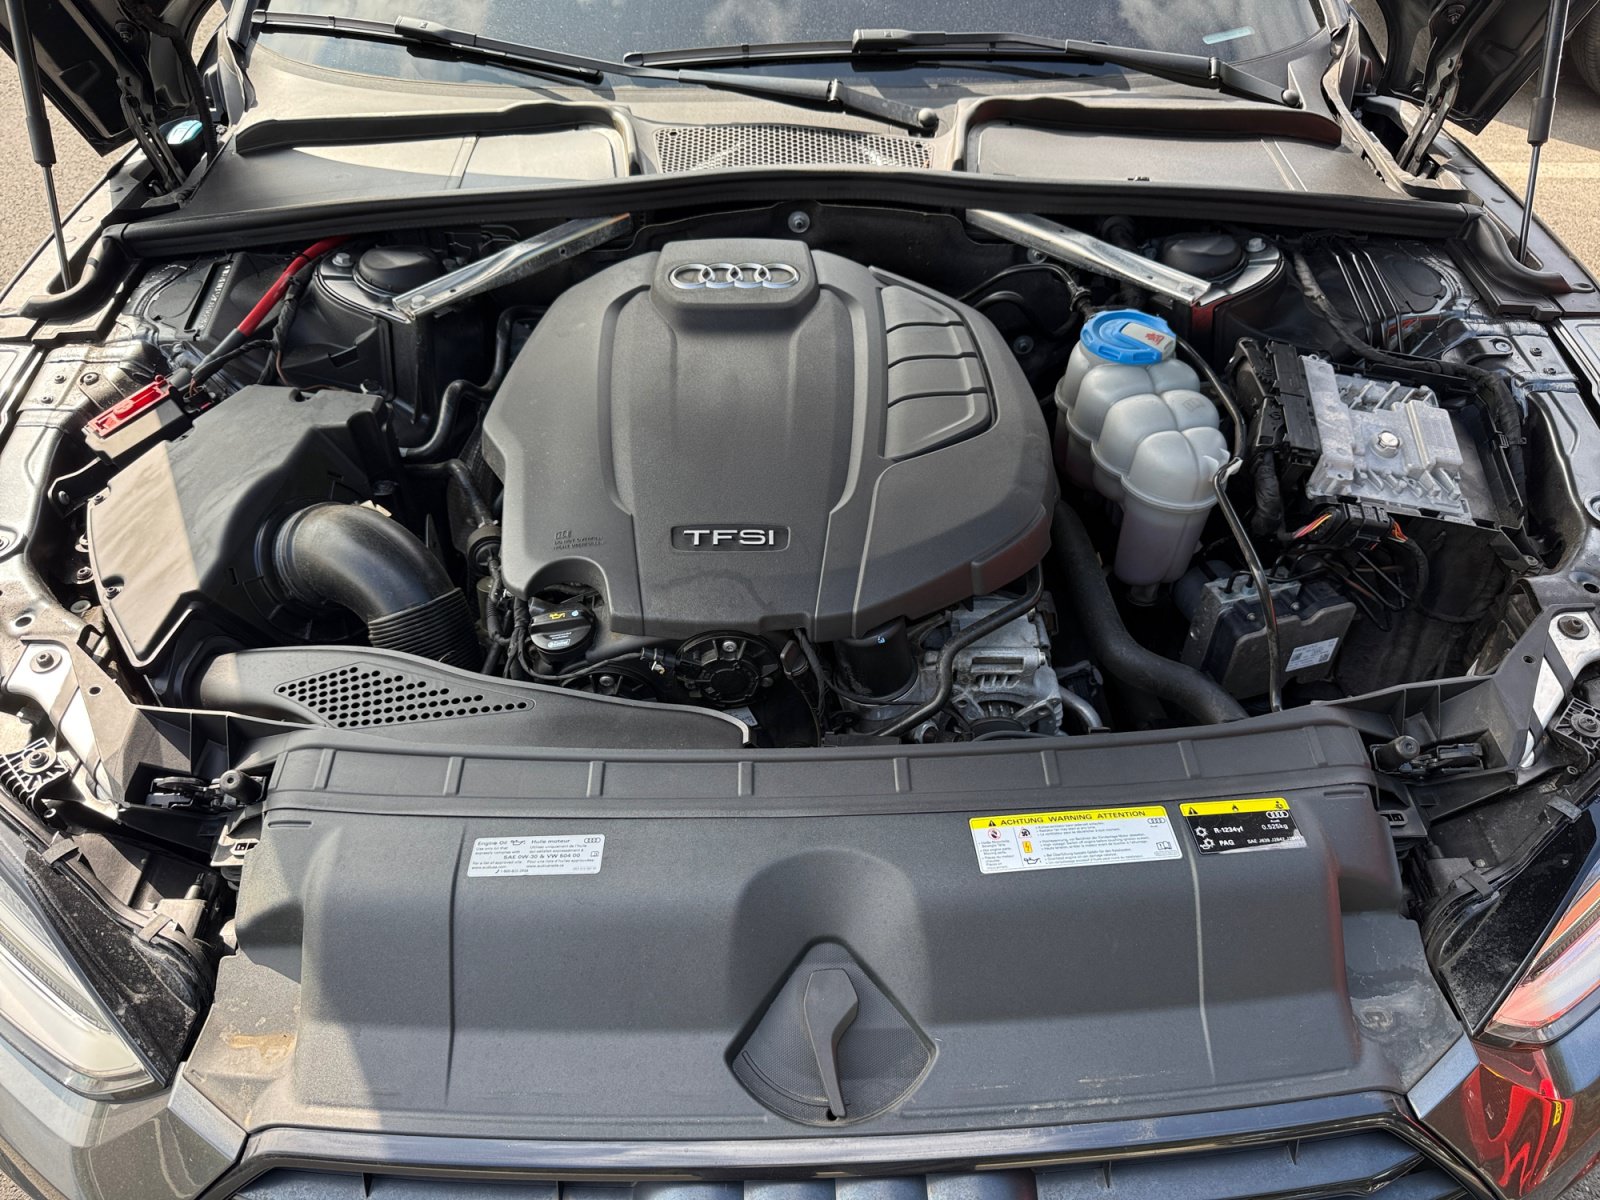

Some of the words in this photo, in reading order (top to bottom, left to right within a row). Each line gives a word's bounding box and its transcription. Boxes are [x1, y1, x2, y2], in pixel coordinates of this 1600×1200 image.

[683, 529, 774, 546] TFSI
[1000, 816, 1044, 826] ACHTUNG
[1048, 813, 1092, 822] WARNING
[1097, 811, 1146, 819] ATTENTION
[1213, 826, 1244, 834] R-1234yf
